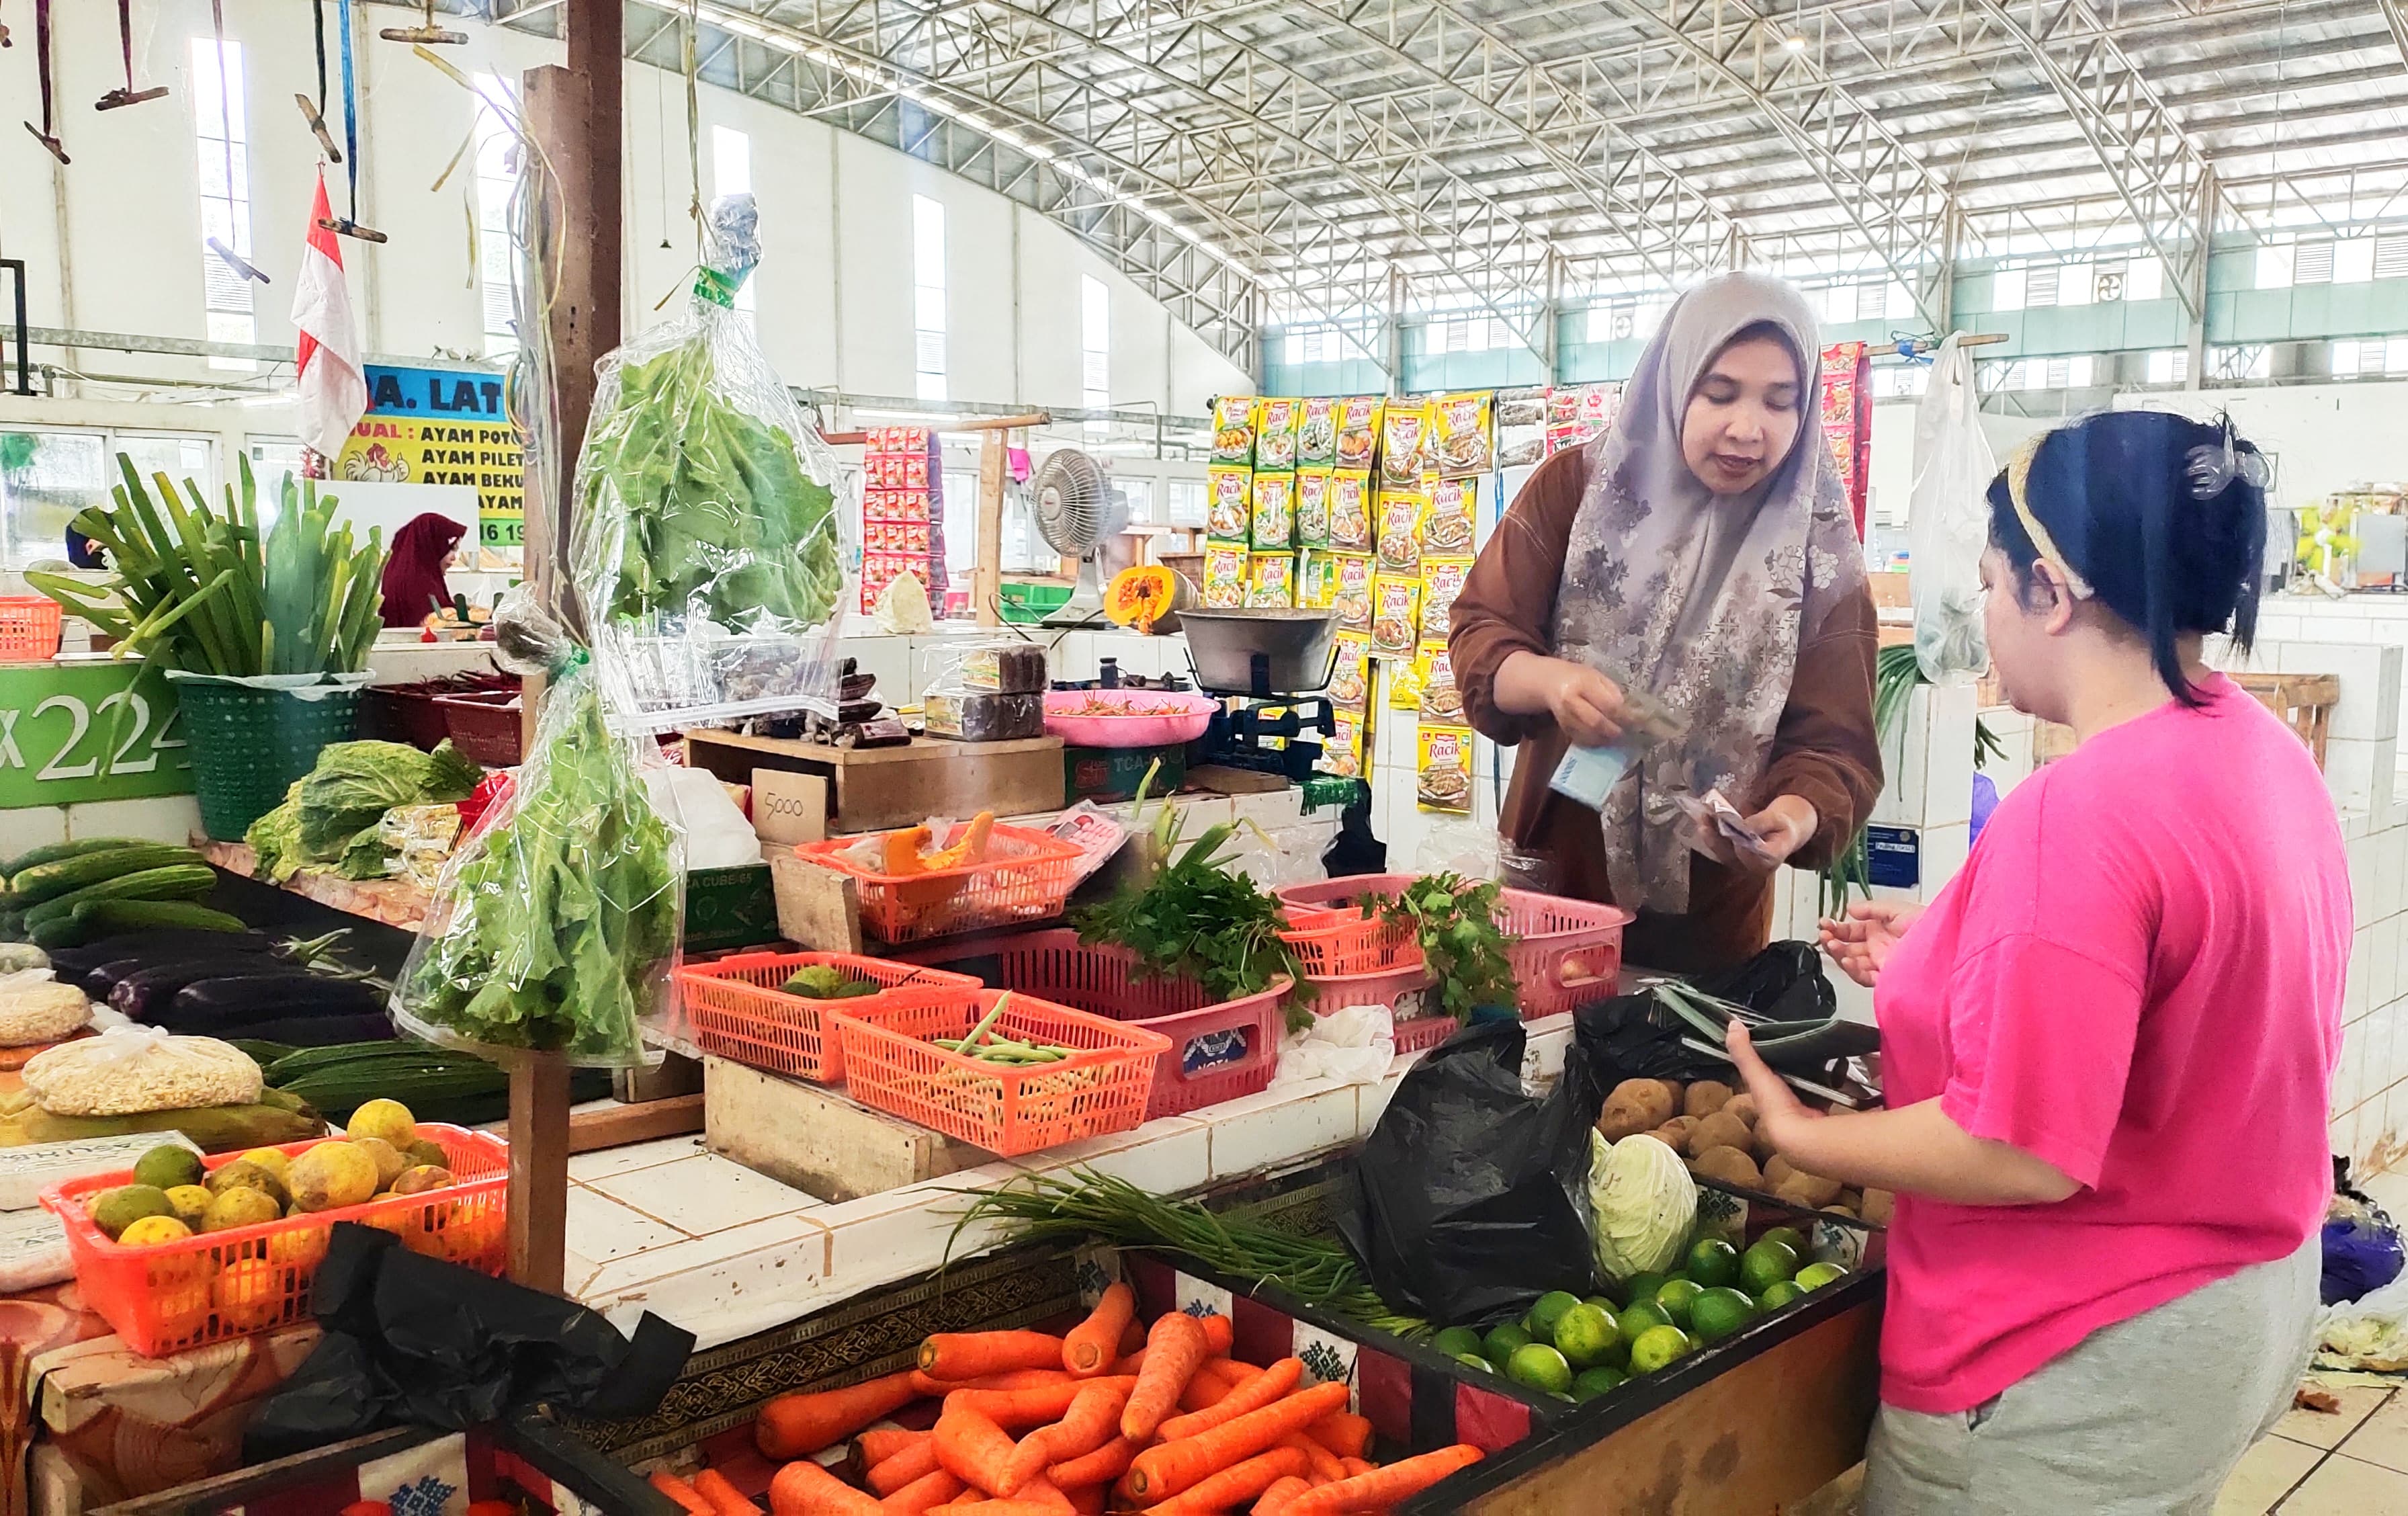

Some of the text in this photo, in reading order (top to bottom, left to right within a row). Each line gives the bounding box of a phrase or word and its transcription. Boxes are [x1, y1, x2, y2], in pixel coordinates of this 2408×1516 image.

[366, 374, 417, 409] A.
[1306, 403, 1330, 419] Racik
[1345, 404, 1371, 420] Racik
[421, 427, 474, 444] AYAM
[422, 450, 523, 466] AYAM PILET
[423, 472, 475, 485] AYAM
[1217, 481, 1242, 498] Racik
[1432, 489, 1463, 506] Racik
[1260, 566, 1284, 582] Racik
[1340, 568, 1365, 583] Racik
[1382, 595, 1409, 609] Racik
[1430, 660, 1450, 676] Rac
[1430, 743, 1460, 759] Racik
[765, 792, 804, 820] 5000
[702, 874, 737, 888] CUBE
